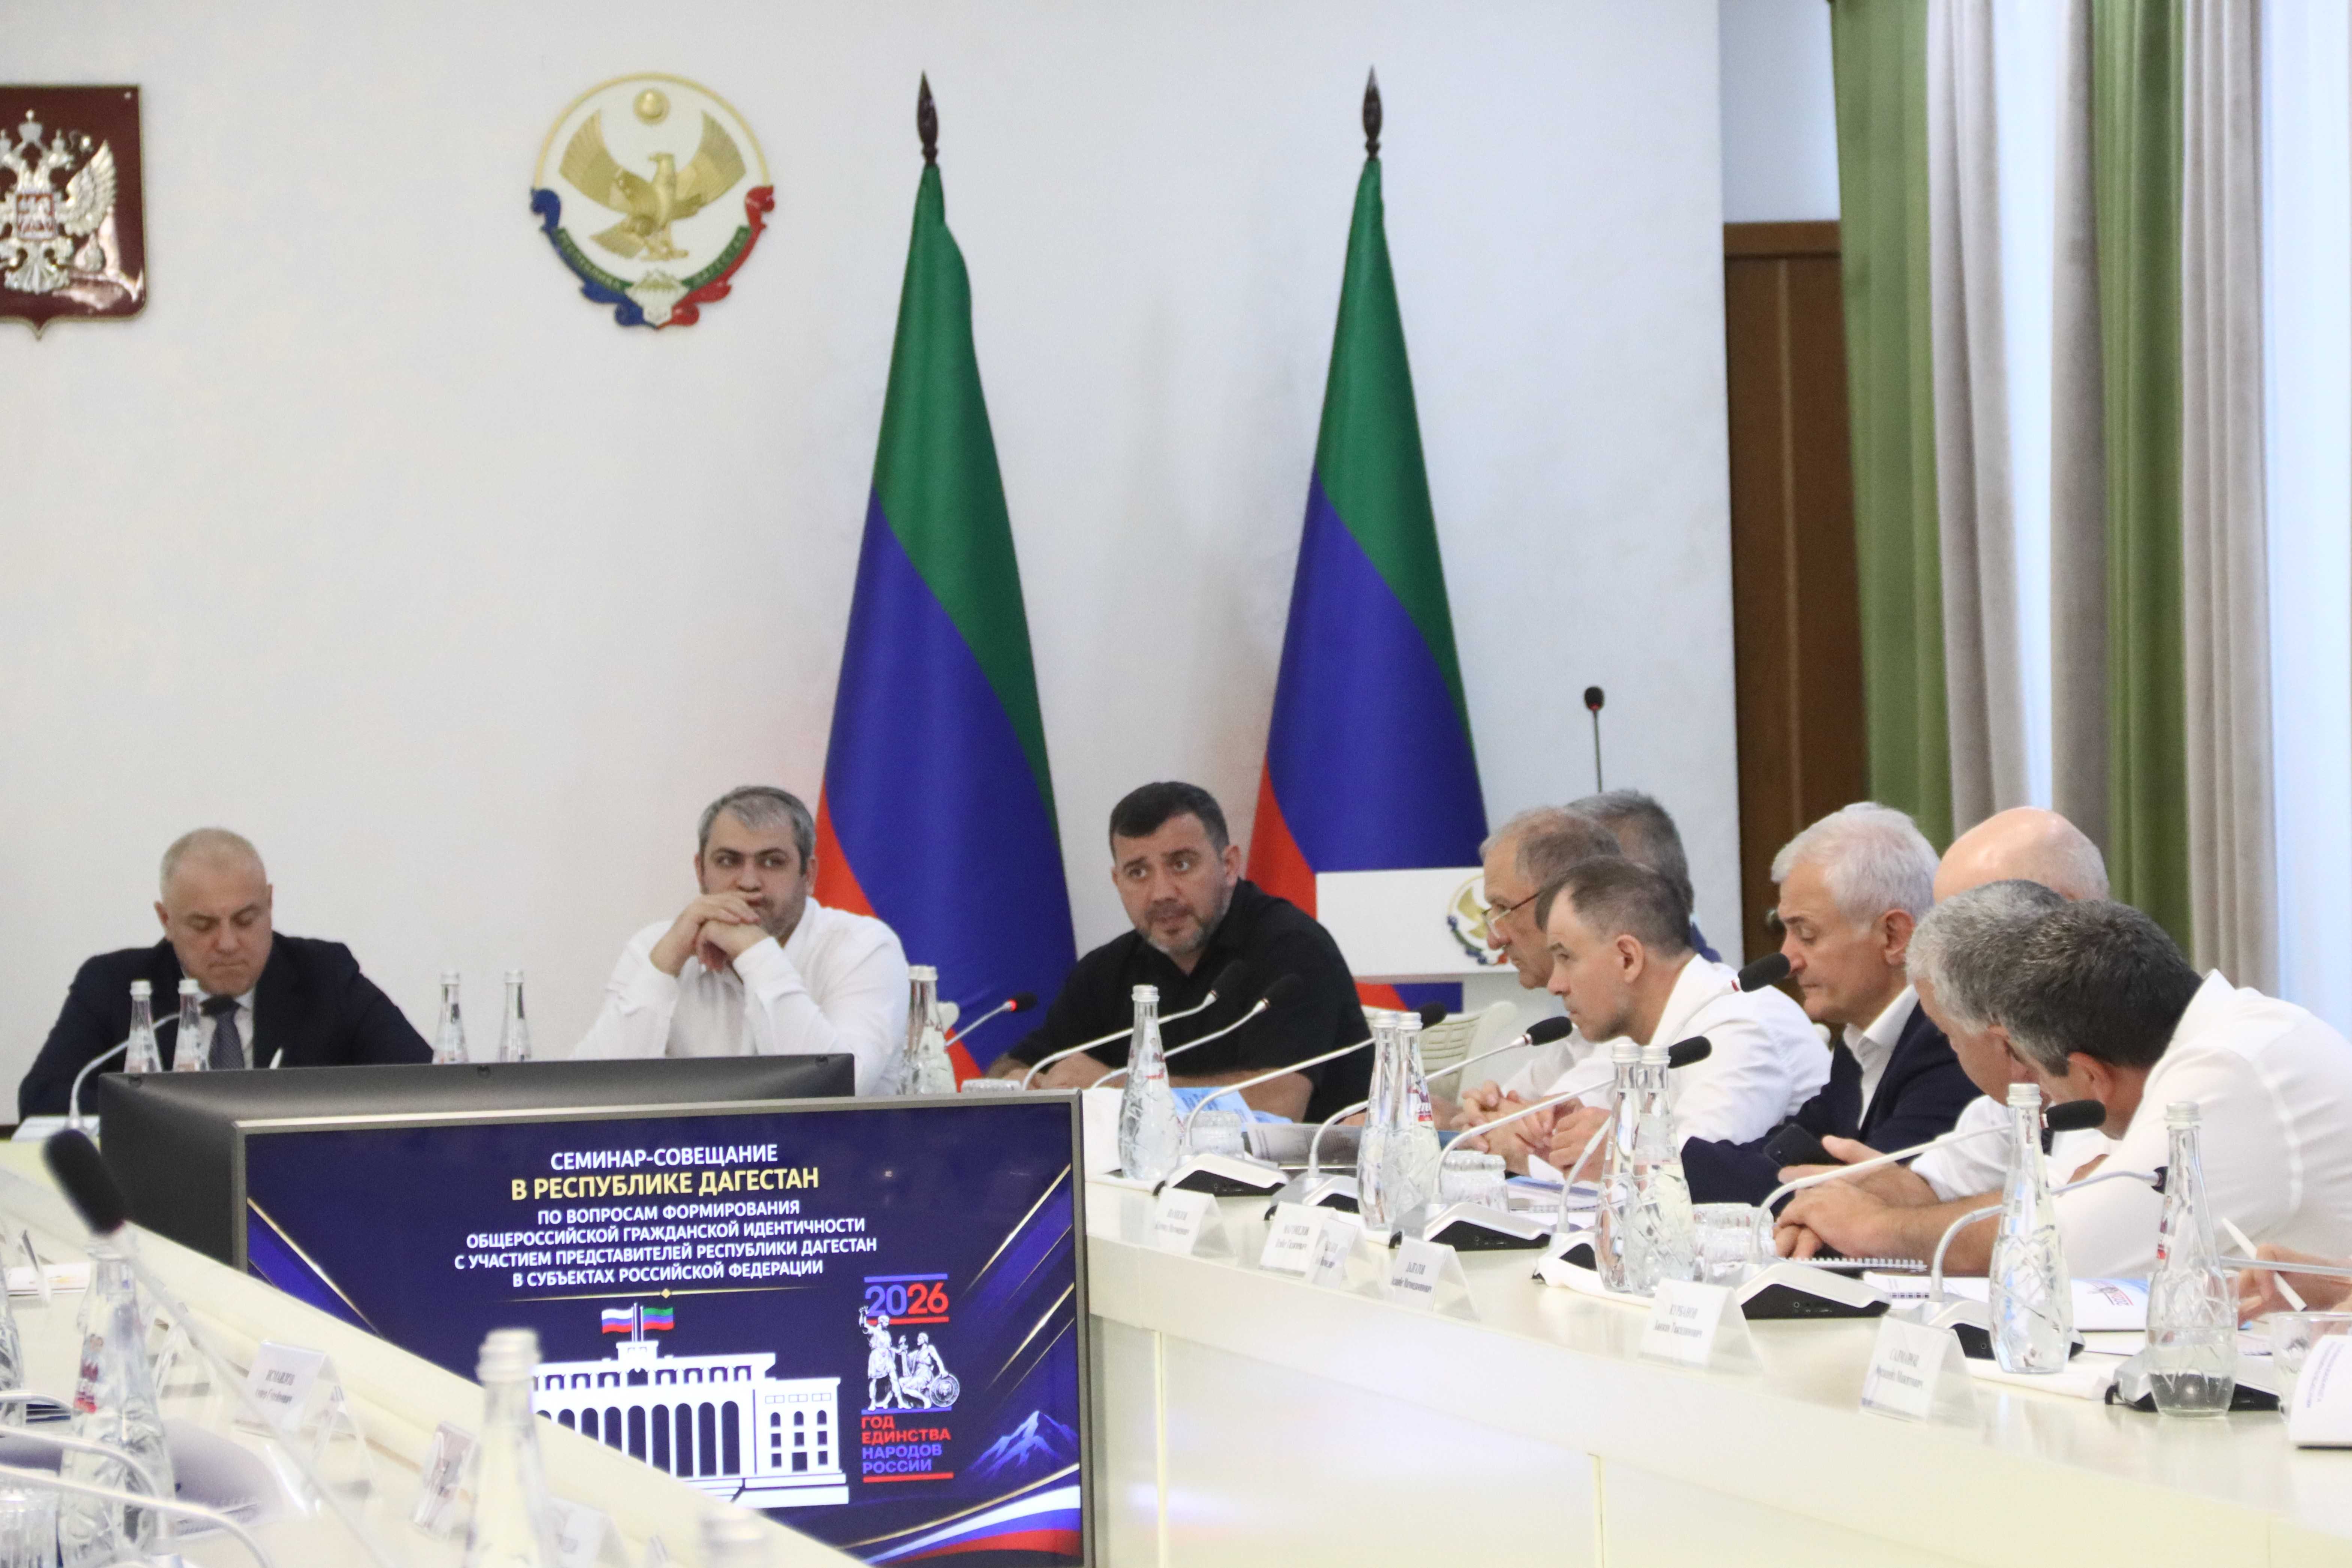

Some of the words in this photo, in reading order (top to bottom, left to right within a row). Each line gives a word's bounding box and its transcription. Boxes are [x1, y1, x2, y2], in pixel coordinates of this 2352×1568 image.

[550, 1144, 778, 1171] СЕМИНАР-СОВЕЩАНИЕ
[511, 1179, 527, 1201] В
[534, 1172, 693, 1200] РЕСПУБЛИКЕ
[698, 1167, 819, 1197] ДАГЕСТАН
[538, 1209, 562, 1225] ПО
[566, 1205, 658, 1224] ВОПРОСАМ
[662, 1199, 800, 1220] ФОРМИРОВАНИЯ
[466, 1225, 619, 1250] ОБЩЕРОССИЙСКОЙ
[623, 1219, 739, 1242] ГРАЖДАНСКОЙ
[743, 1217, 865, 1239] ИДЕНТИЧНОСТИ
[454, 1254, 465, 1270] С
[468, 1251, 552, 1269] УЧАСТИЕМ
[556, 1241, 693, 1266] ПРЕДСТАВИТЕЛЕЙ
[696, 1240, 798, 1259] РЕСПУБЛИКИ
[800, 1237, 877, 1257] ДАГЕСТАН
[512, 1272, 524, 1287] В
[526, 1268, 615, 1287] СУБЪЕКТАХ
[619, 1260, 724, 1283] РОССИЙСКОЙ
[728, 1259, 823, 1280] ФЕДЕРАЦИИ
[865, 1282, 949, 1317] 2026
[862, 1415, 896, 1429] ГОД
[862, 1428, 951, 1446] ЕДИНСТВА
[863, 1444, 942, 1460] НАРОДОВ
[863, 1459, 932, 1474] РОССИИ
